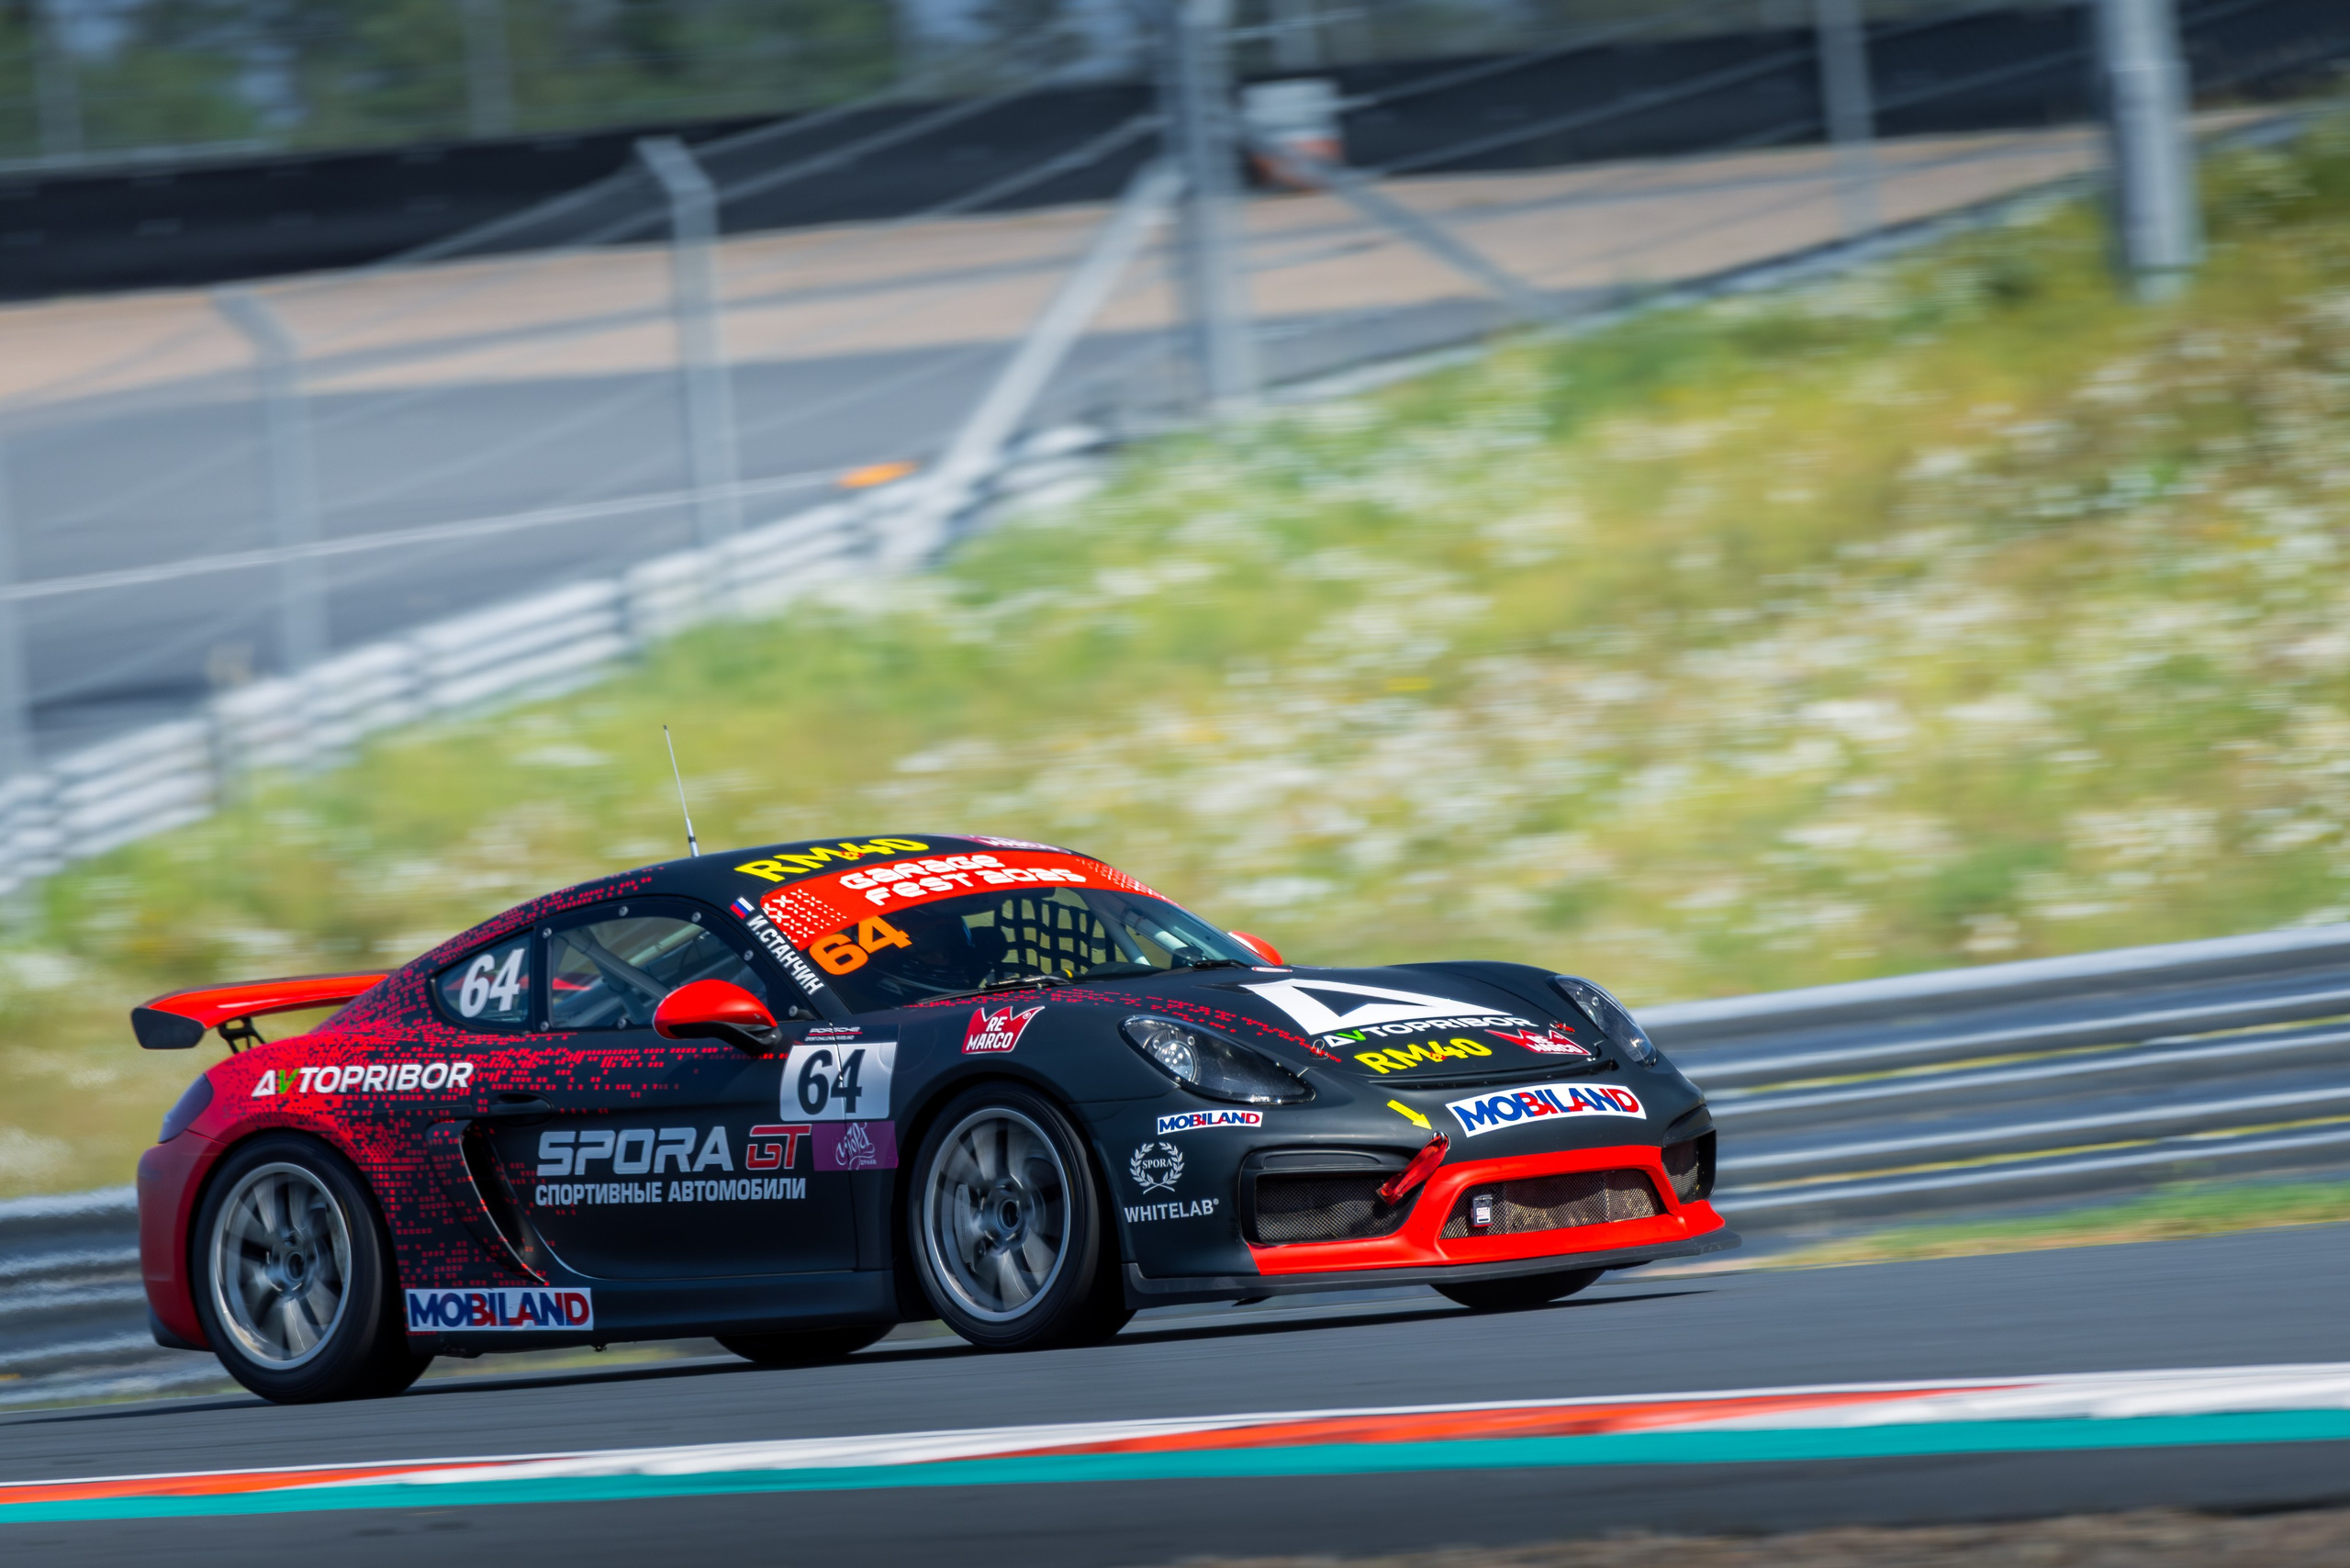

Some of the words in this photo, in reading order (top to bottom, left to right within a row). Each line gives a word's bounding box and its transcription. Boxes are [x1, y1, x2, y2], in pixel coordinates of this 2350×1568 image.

[974, 868, 1086, 885] 2025
[746, 914, 824, 995] И.СТАНЧИН
[809, 915, 912, 976] 64
[460, 948, 525, 1018] 64
[966, 1032, 1013, 1051] MARCO
[986, 1016, 1008, 1032] RE
[1323, 1017, 1539, 1047] AVTOPRIBOR
[252, 1062, 474, 1097] AVTOPRIBOR
[798, 1049, 866, 1115] 64
[1159, 1112, 1260, 1133] MOBILAND
[1452, 1087, 1639, 1132] MOBILAND
[536, 1126, 734, 1176] SPORA
[745, 1124, 812, 1170] GT
[1142, 1158, 1173, 1170] SPORA
[535, 1182, 662, 1205] СПОРТИВНЫЕ
[667, 1178, 806, 1203] АВТОМОБИЛИ
[409, 1292, 589, 1327] MOBILAND
